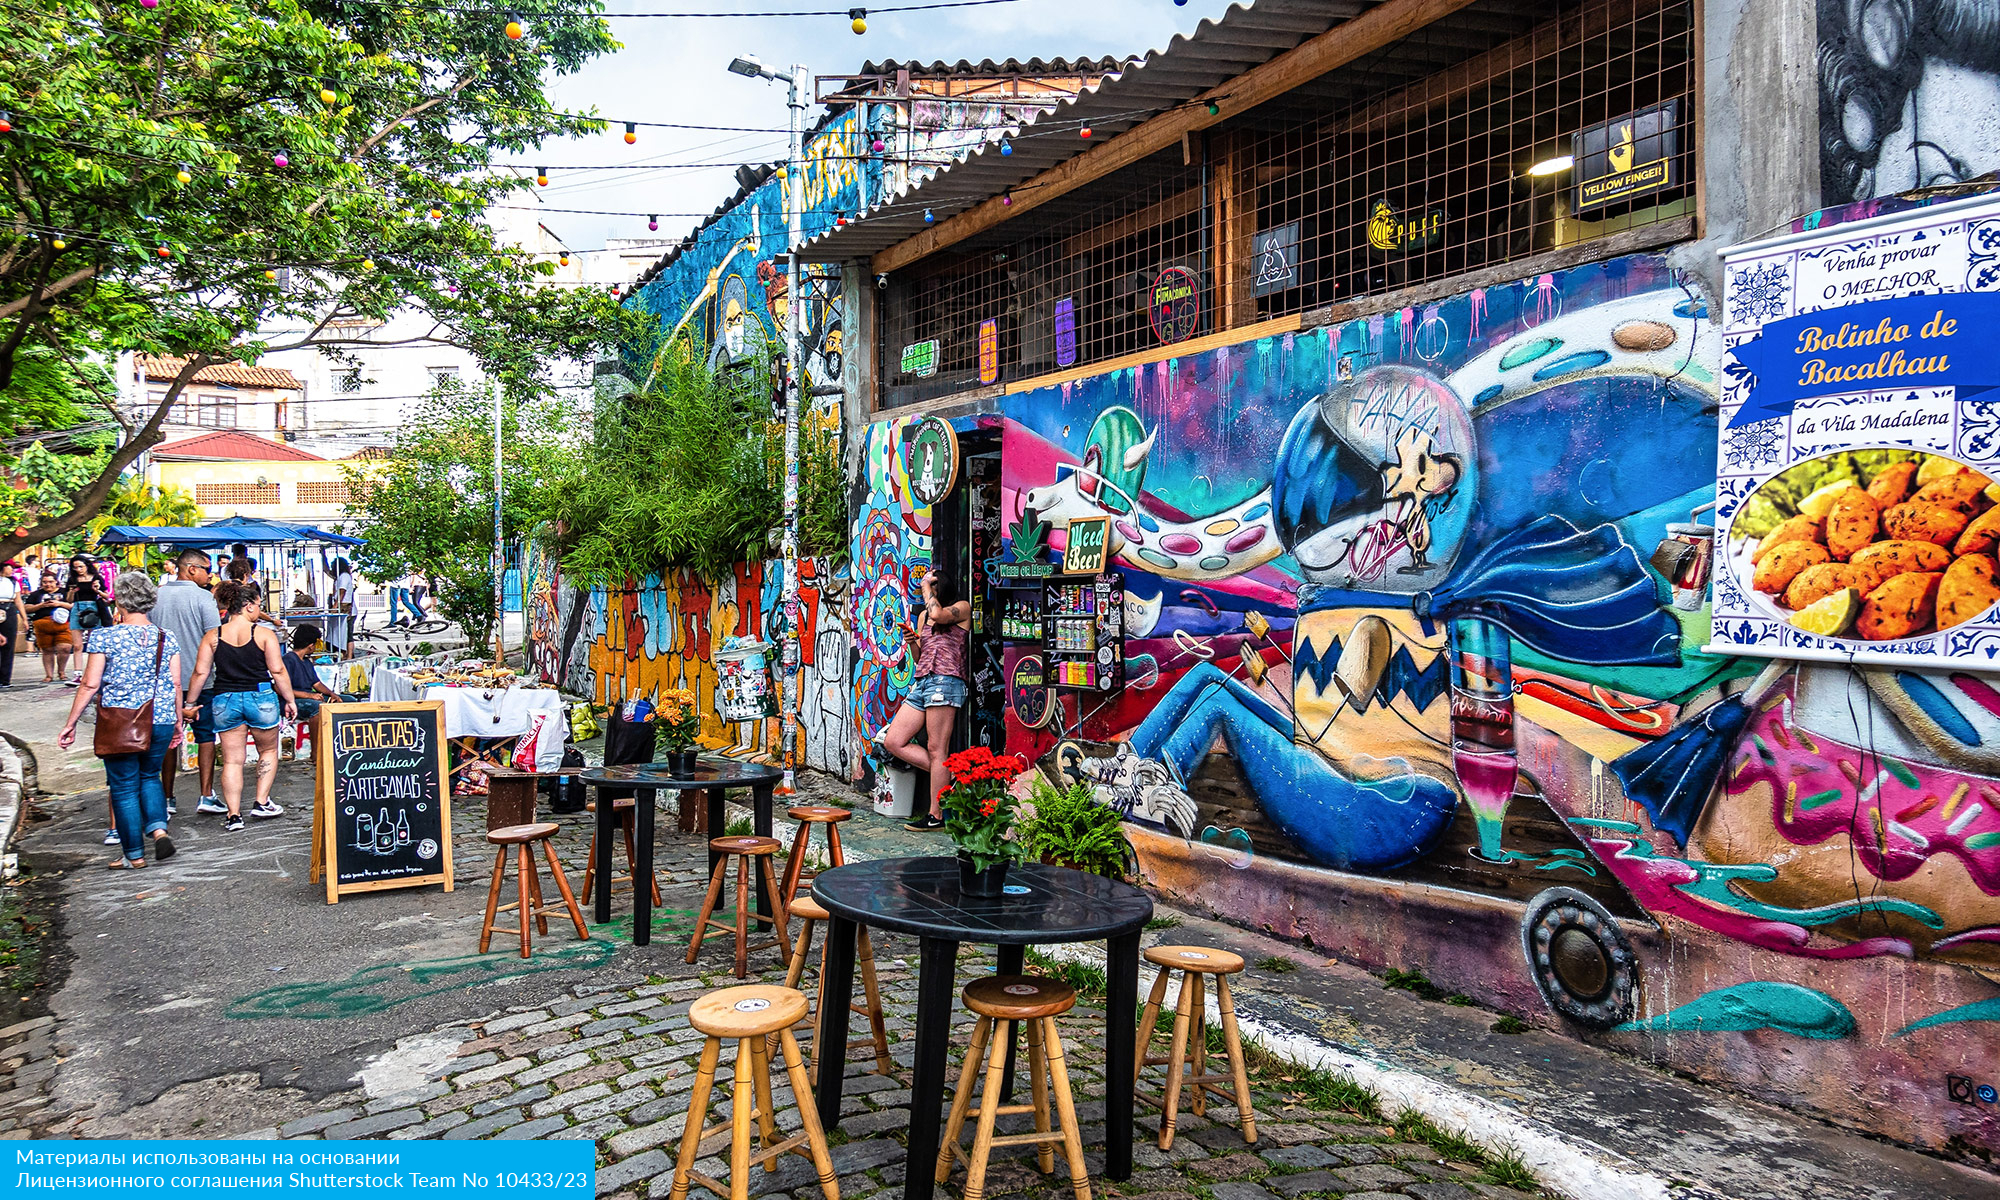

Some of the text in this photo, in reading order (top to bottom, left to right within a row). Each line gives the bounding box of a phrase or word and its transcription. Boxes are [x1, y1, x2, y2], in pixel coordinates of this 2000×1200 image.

[1584, 177, 1624, 197] YELLOW
[1625, 166, 1662, 186] FINGER
[1397, 214, 1439, 244] PUFF
[1823, 243, 1942, 274] Venha provar
[1822, 269, 1941, 300] O MELHOR
[1794, 309, 1958, 354] Bolinho de
[1797, 349, 1951, 386] Bacalhau
[1796, 411, 1950, 435] da Vila Madalena
[1070, 521, 1106, 548] Weed
[1031, 563, 1054, 576] HEMP
[1067, 545, 1101, 571] Beer
[341, 719, 415, 750] CERVEJAS
[338, 751, 425, 777] Canábicas
